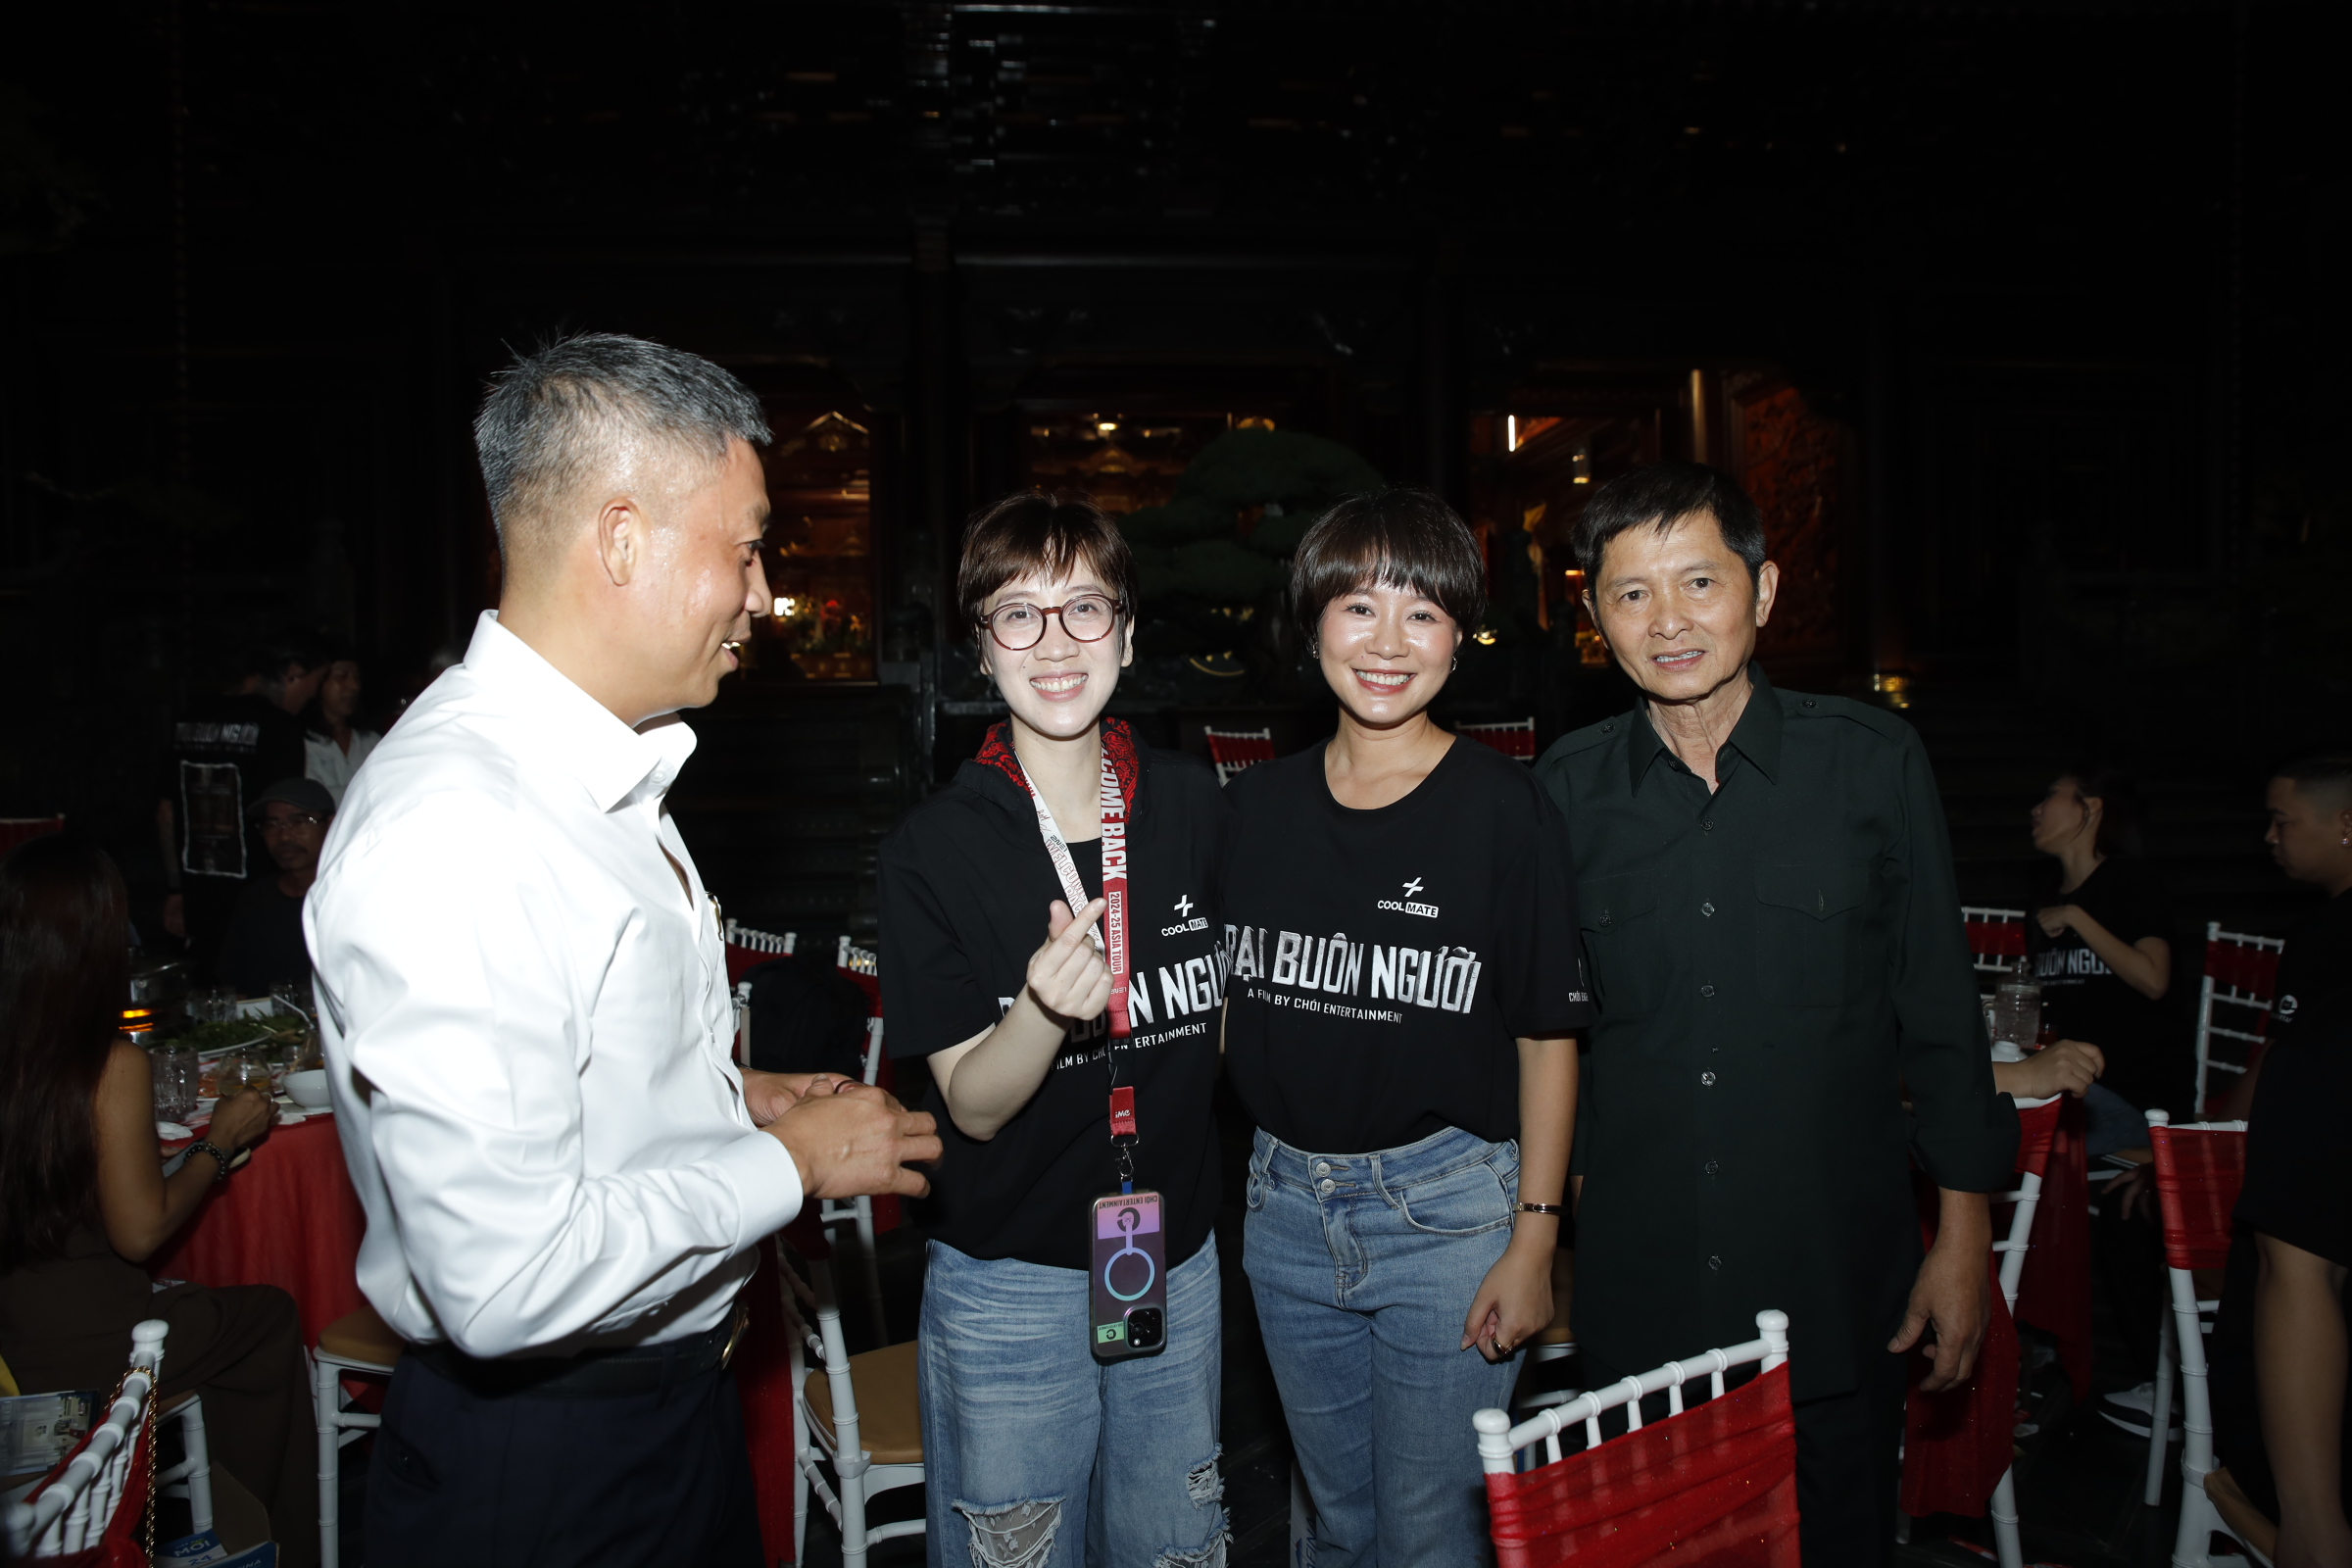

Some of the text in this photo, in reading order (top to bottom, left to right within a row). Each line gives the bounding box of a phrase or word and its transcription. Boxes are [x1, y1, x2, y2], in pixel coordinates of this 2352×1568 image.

[1064, 885, 1088, 918] BAC
[1110, 893, 1122, 973] 2024-25 ASIA TOUR
[1272, 930, 1365, 997] BUÔN
[1370, 945, 1483, 1013] NGƯỜI
[1248, 987, 1403, 1025] A FILM BY CHÓI ENTERTAINMENT
[1076, 1052, 1089, 1065] BY
[1099, 1197, 1143, 1209] ENTERTAINMENT
